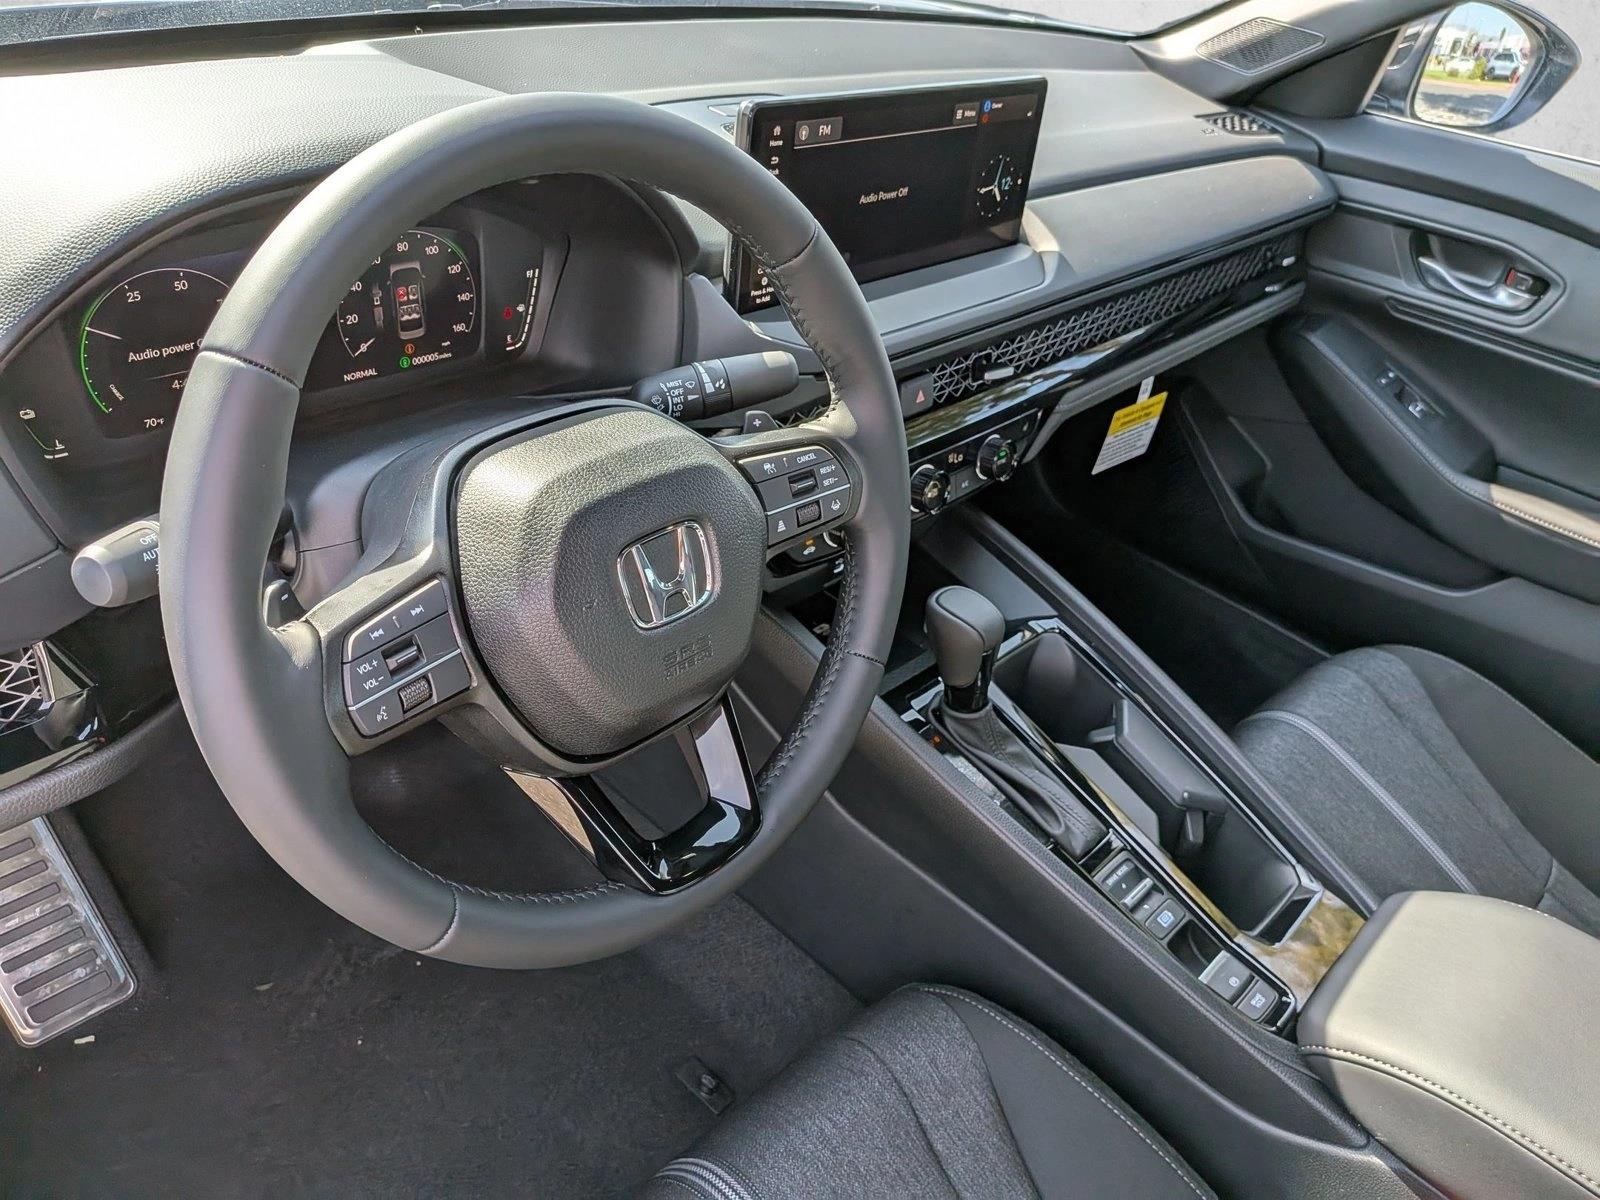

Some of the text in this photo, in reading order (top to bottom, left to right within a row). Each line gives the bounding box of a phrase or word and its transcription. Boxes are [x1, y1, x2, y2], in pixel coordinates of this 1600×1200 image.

[818, 124, 832, 136] FM
[1001, 177, 1011, 191] 12
[859, 194, 878, 205] Audio
[878, 191, 897, 201] Power
[396, 241, 409, 252] 80
[425, 245, 439, 255] 100
[447, 264, 461, 275] 120
[174, 280, 189, 291] 50
[126, 291, 142, 303] 25
[457, 292, 471, 302] 140
[345, 313, 359, 325] 20
[453, 322, 466, 333] 160
[127, 348, 160, 363] Audio
[161, 341, 195, 357] power
[412, 352, 439, 366] 000005
[343, 367, 378, 382] NORMAL
[666, 379, 683, 388] MIST
[670, 387, 685, 397] OFF
[672, 395, 685, 404] INT
[673, 403, 684, 412] LO
[796, 452, 817, 464] CANCEL
[140, 532, 158, 546] OFF
[142, 547, 160, 562] AUT
